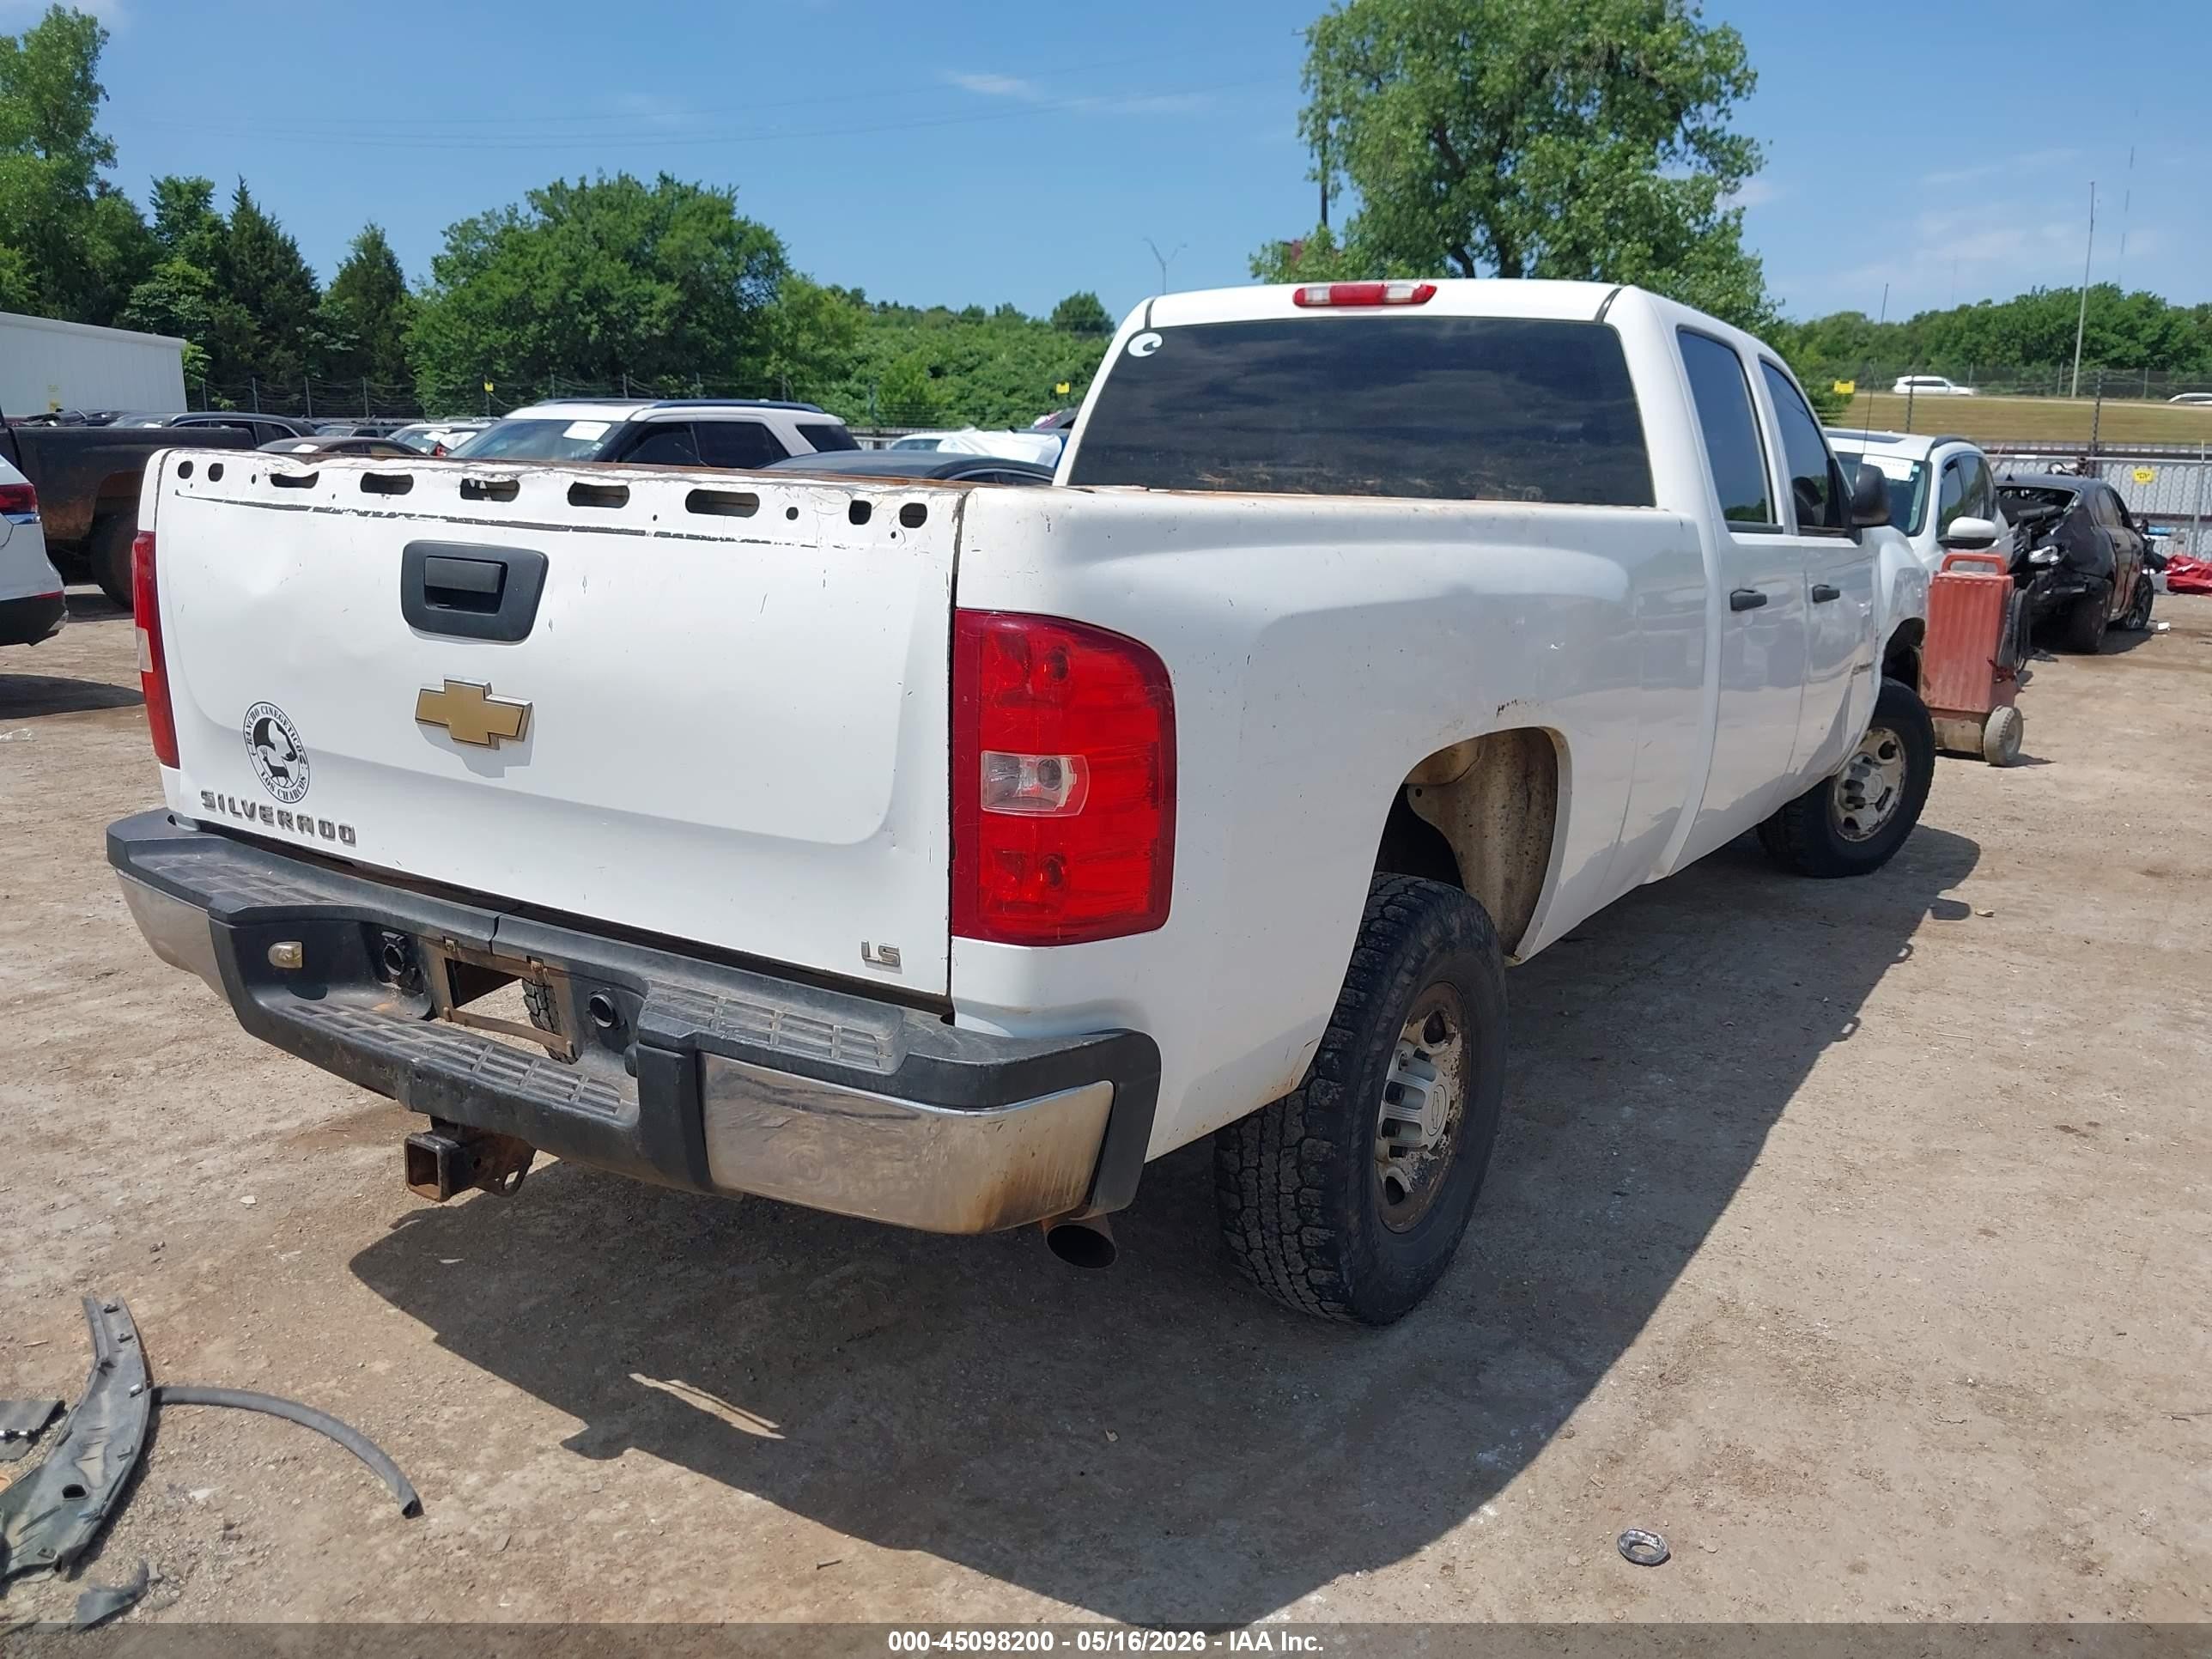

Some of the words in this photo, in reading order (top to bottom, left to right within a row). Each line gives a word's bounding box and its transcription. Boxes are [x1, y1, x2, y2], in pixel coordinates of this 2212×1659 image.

[246, 708, 260, 745] RANCHO
[261, 771, 276, 792] LOS
[277, 775, 307, 800] CHARCOS
[201, 790, 356, 846] SILVERADO
[860, 940, 901, 968] LS
